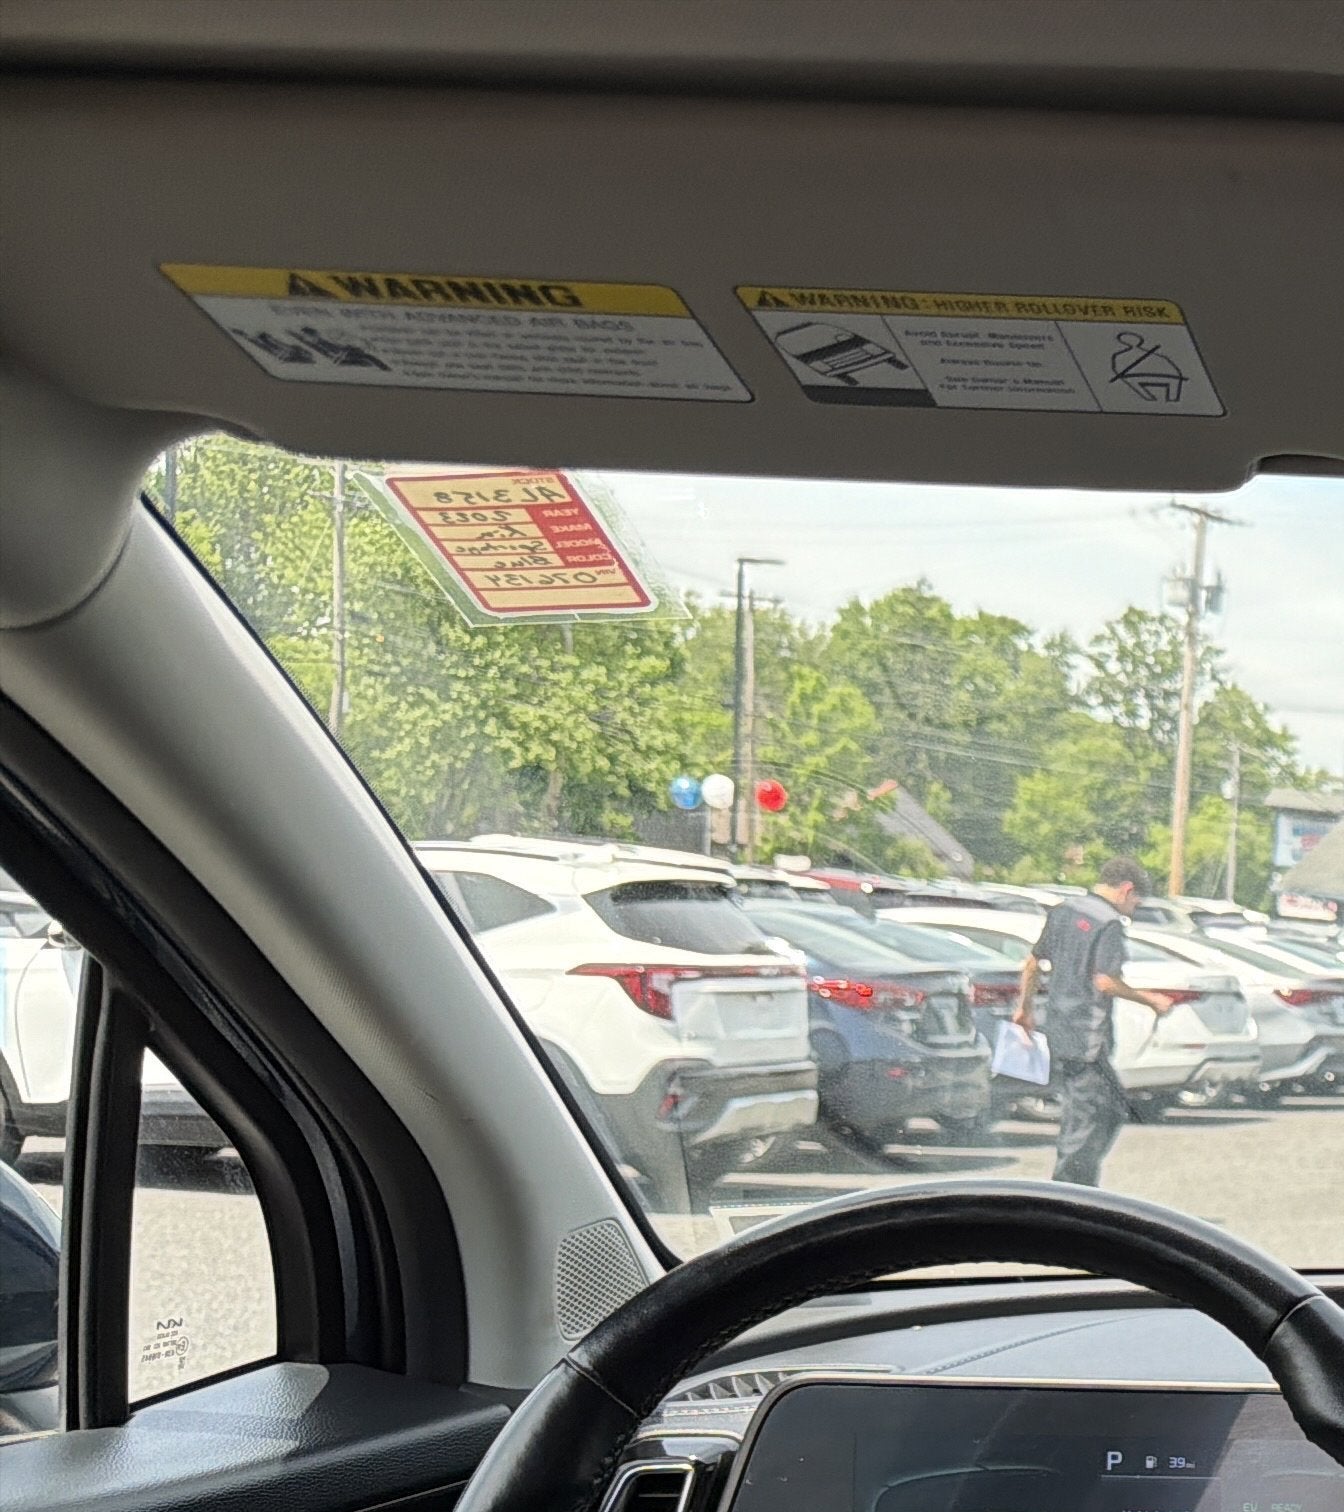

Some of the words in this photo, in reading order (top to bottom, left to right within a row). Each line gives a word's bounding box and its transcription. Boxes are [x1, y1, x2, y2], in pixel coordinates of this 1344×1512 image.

[328, 275, 583, 307] WARNING
[936, 299, 1011, 315] HIGHER
[1016, 302, 1117, 318] ROLLOVER
[1122, 304, 1172, 320] RISK
[574, 317, 635, 332] BAGS
[1106, 1450, 1123, 1471] P
[1168, 1456, 1187, 1469] 39
[1242, 1502, 1258, 1512] EV
[1271, 1503, 1303, 1512] READY
